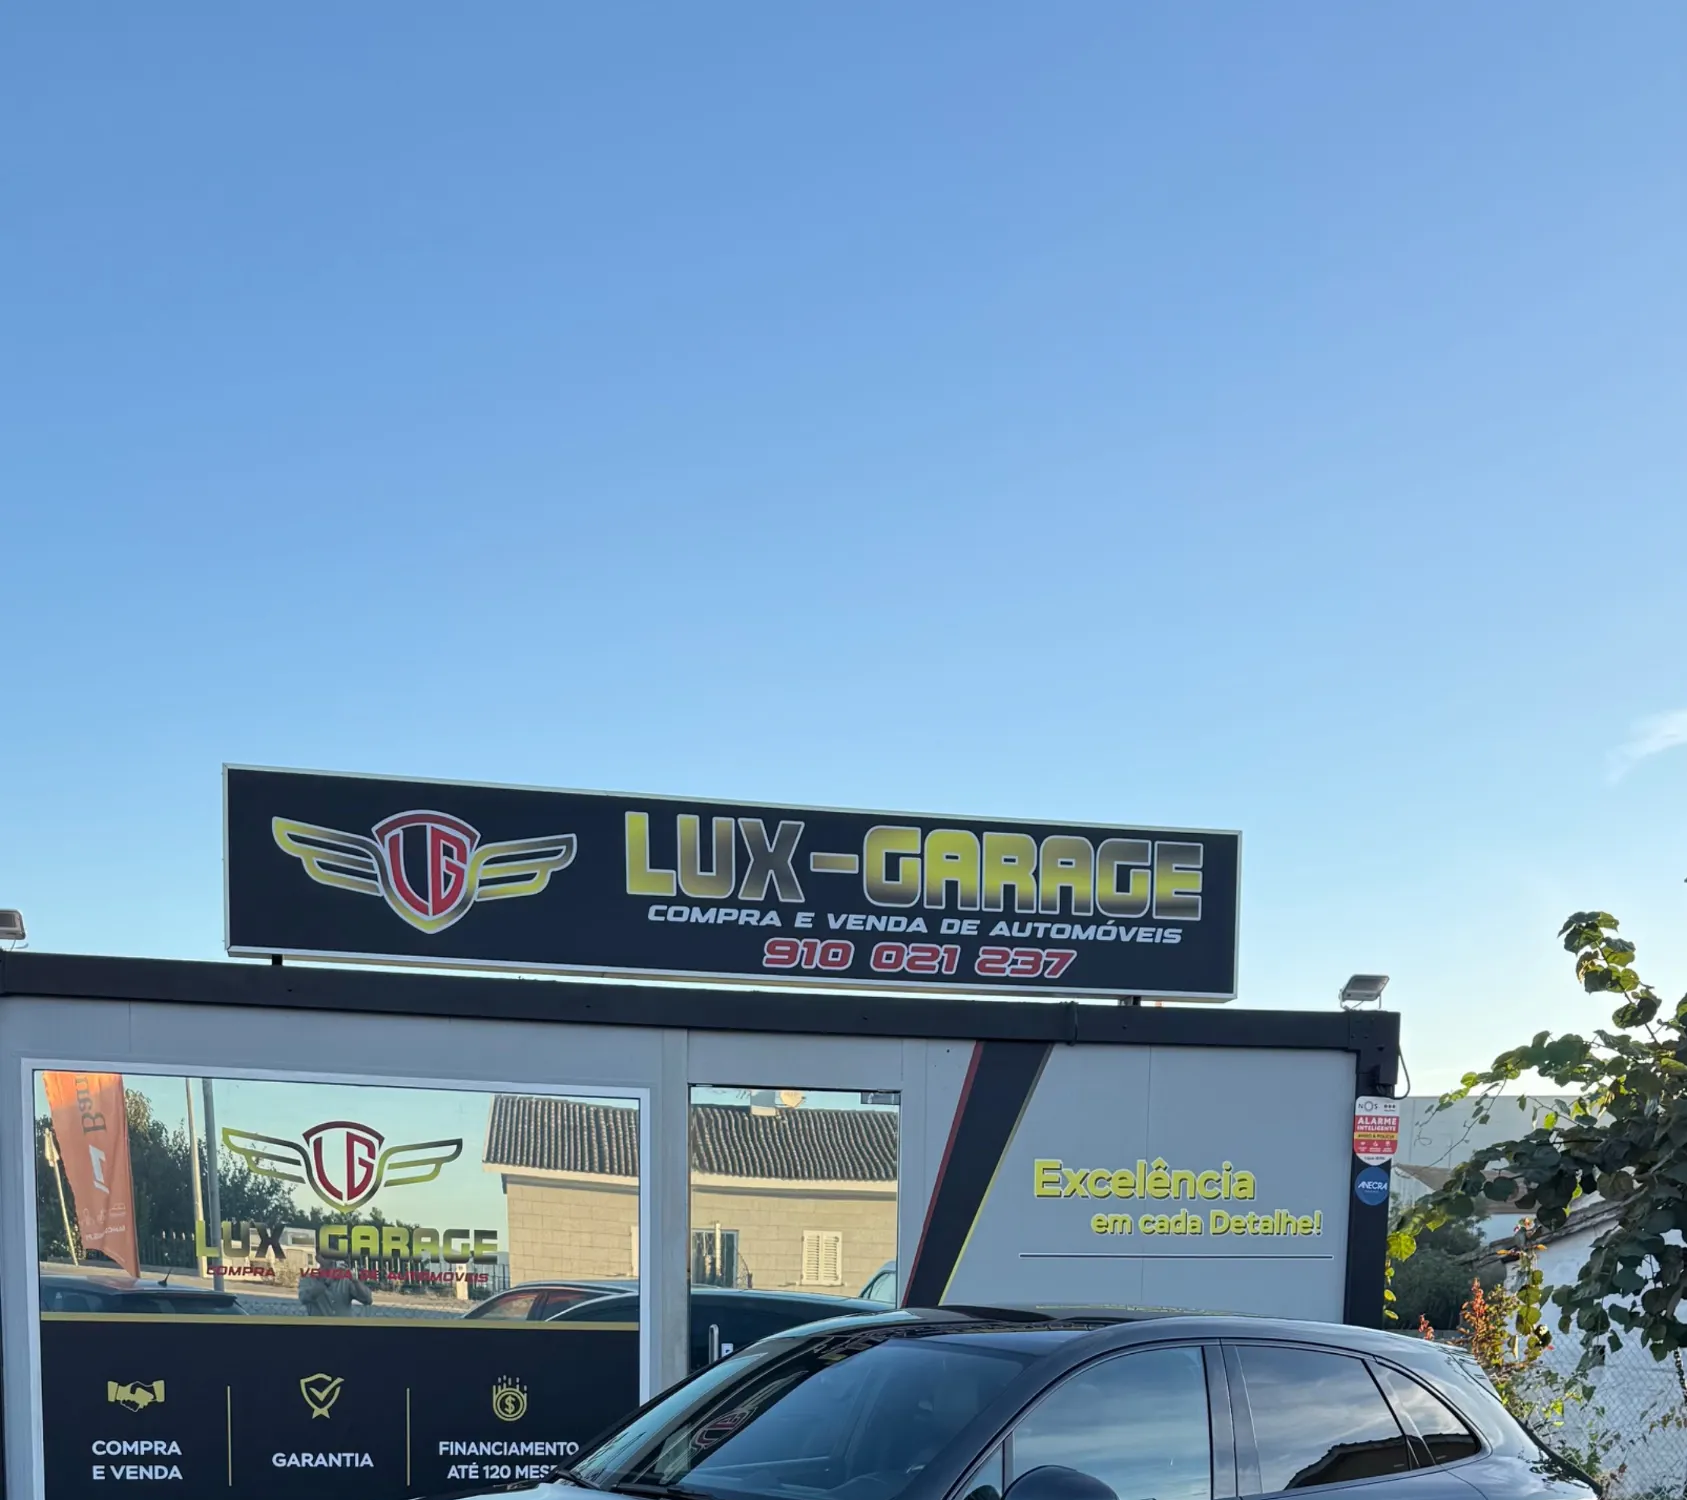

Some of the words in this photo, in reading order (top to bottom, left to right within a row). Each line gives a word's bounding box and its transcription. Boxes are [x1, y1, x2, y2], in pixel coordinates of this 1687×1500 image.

[625, 811, 1203, 920] LUX-GARAGE
[648, 905, 782, 926] COMPRA
[794, 912, 815, 928] E
[827, 913, 928, 933] VENDA
[940, 918, 981, 936] DE
[989, 920, 1182, 944] AUTOMÓVEIS
[762, 937, 854, 970] 910
[870, 942, 960, 974] 021
[974, 946, 1077, 978] 237
[1357, 1116, 1397, 1126] ALARME
[1034, 1157, 1256, 1201] Excelência
[1358, 1181, 1388, 1191] ANECRA
[1091, 1213, 1133, 1235] em
[1138, 1209, 1203, 1236] cada
[1209, 1209, 1324, 1237] Detalhe!
[206, 1265, 276, 1278] COMPRA
[300, 1267, 353, 1282] VENDA
[91, 1440, 182, 1456] COMPRA
[438, 1441, 580, 1456] FINANCIAMENTO
[271, 1452, 374, 1468] GARANTIA
[92, 1465, 105, 1480] E
[110, 1465, 183, 1480] VENDA
[447, 1462, 479, 1479] ATÉ
[483, 1465, 511, 1479] 120
